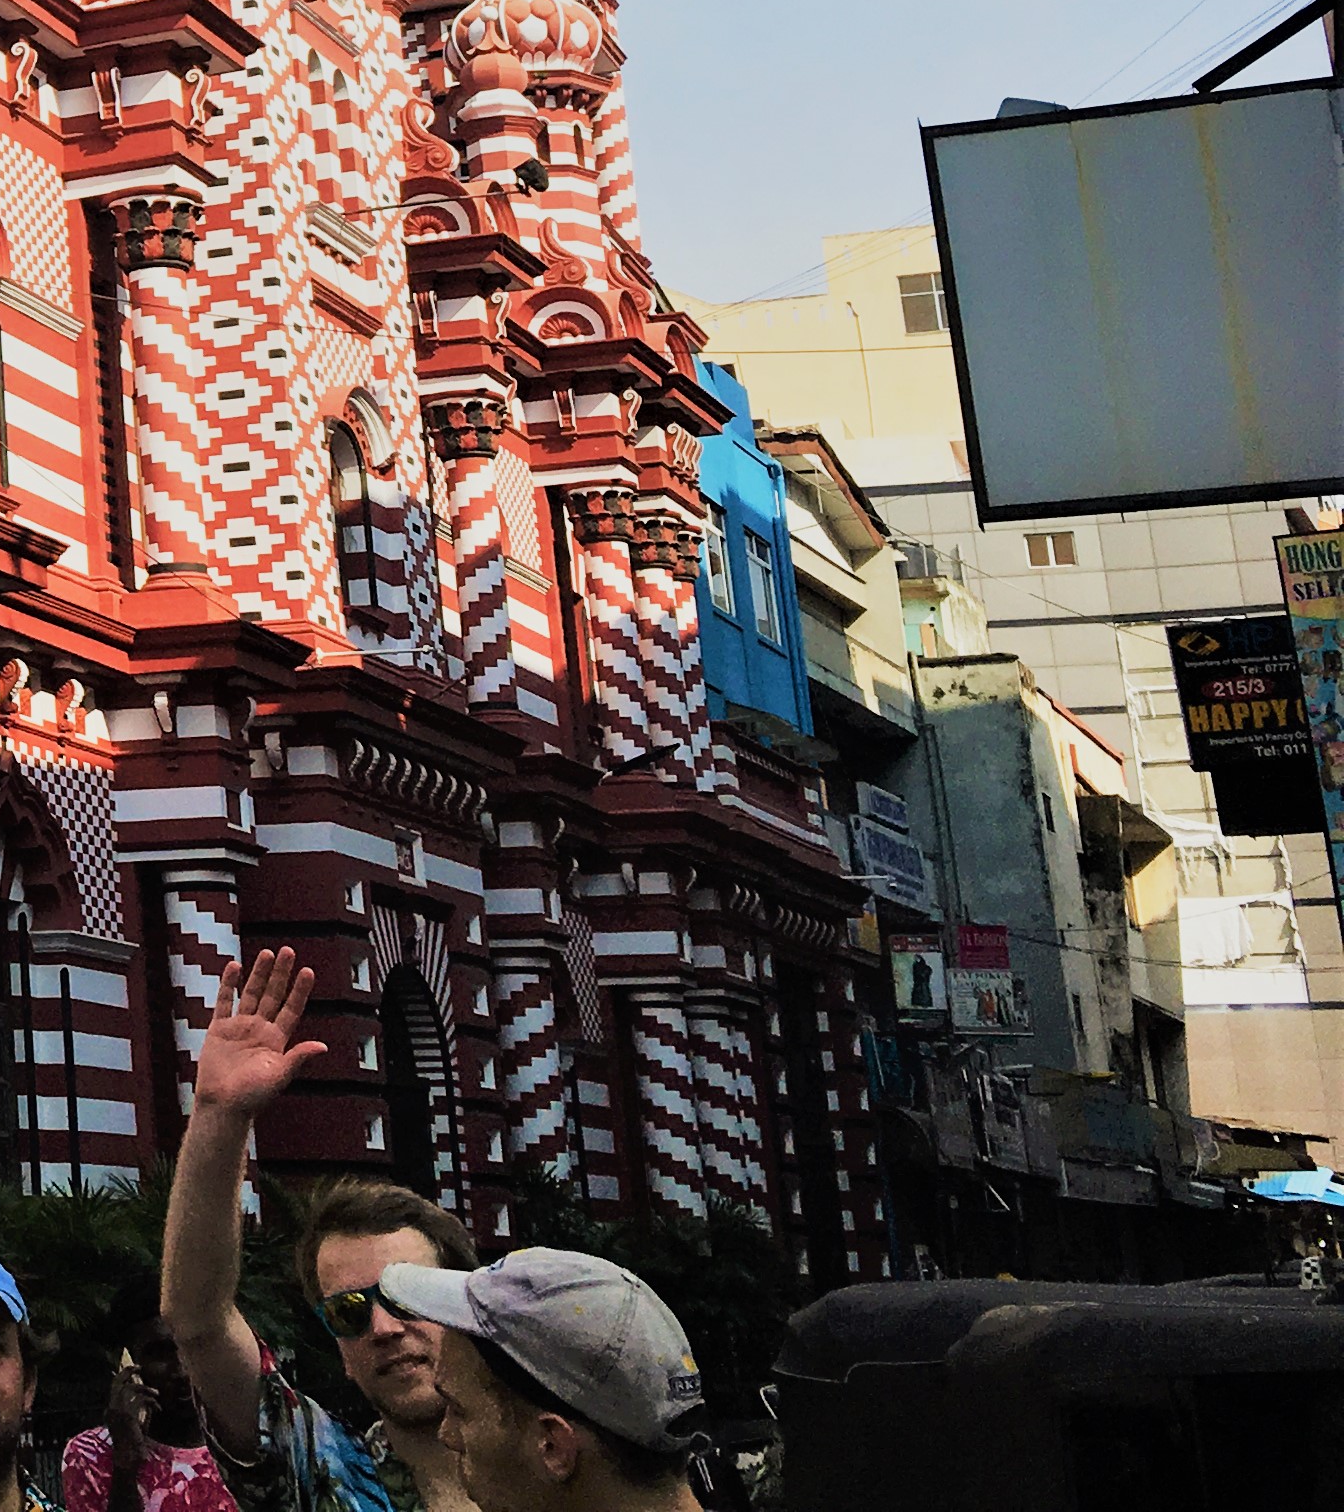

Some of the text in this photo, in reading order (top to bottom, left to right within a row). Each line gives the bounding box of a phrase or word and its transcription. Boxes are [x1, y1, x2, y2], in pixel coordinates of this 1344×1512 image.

[1284, 540, 1341, 574] HONG
[1213, 678, 1266, 698] 215/3
[1187, 699, 1289, 734] HAPPY
[1266, 732, 1295, 744] Fancy
[1254, 745, 1280, 758] Tel:
